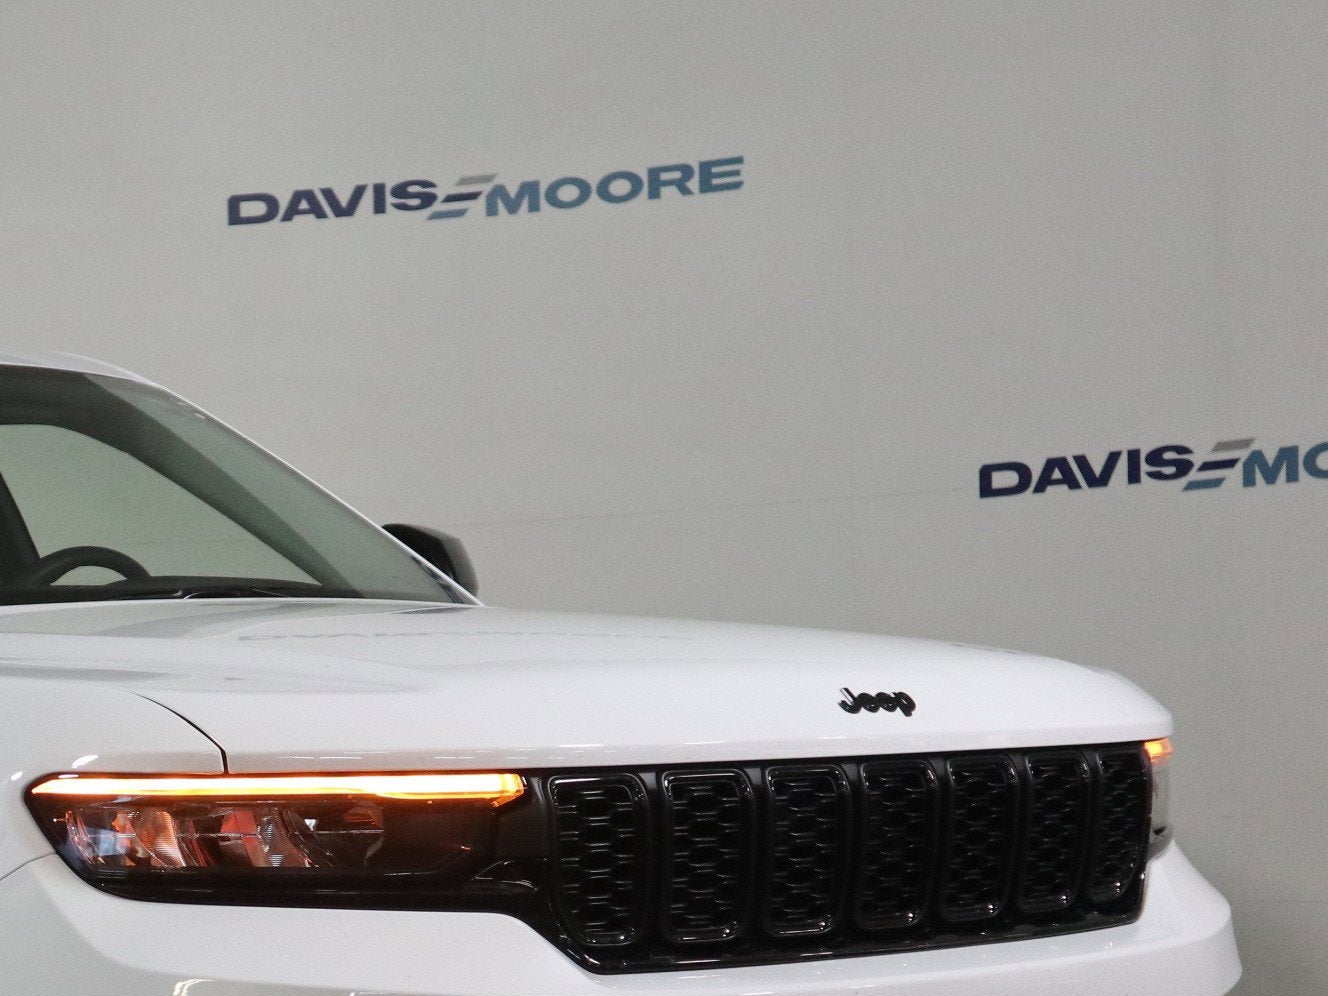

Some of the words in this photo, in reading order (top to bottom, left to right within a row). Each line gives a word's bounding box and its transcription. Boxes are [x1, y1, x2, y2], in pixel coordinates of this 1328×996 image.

[226, 178, 439, 226] DAVIS
[484, 156, 745, 218] MOORE
[978, 444, 1195, 499] DAVIS
[836, 686, 917, 718] Jeep
